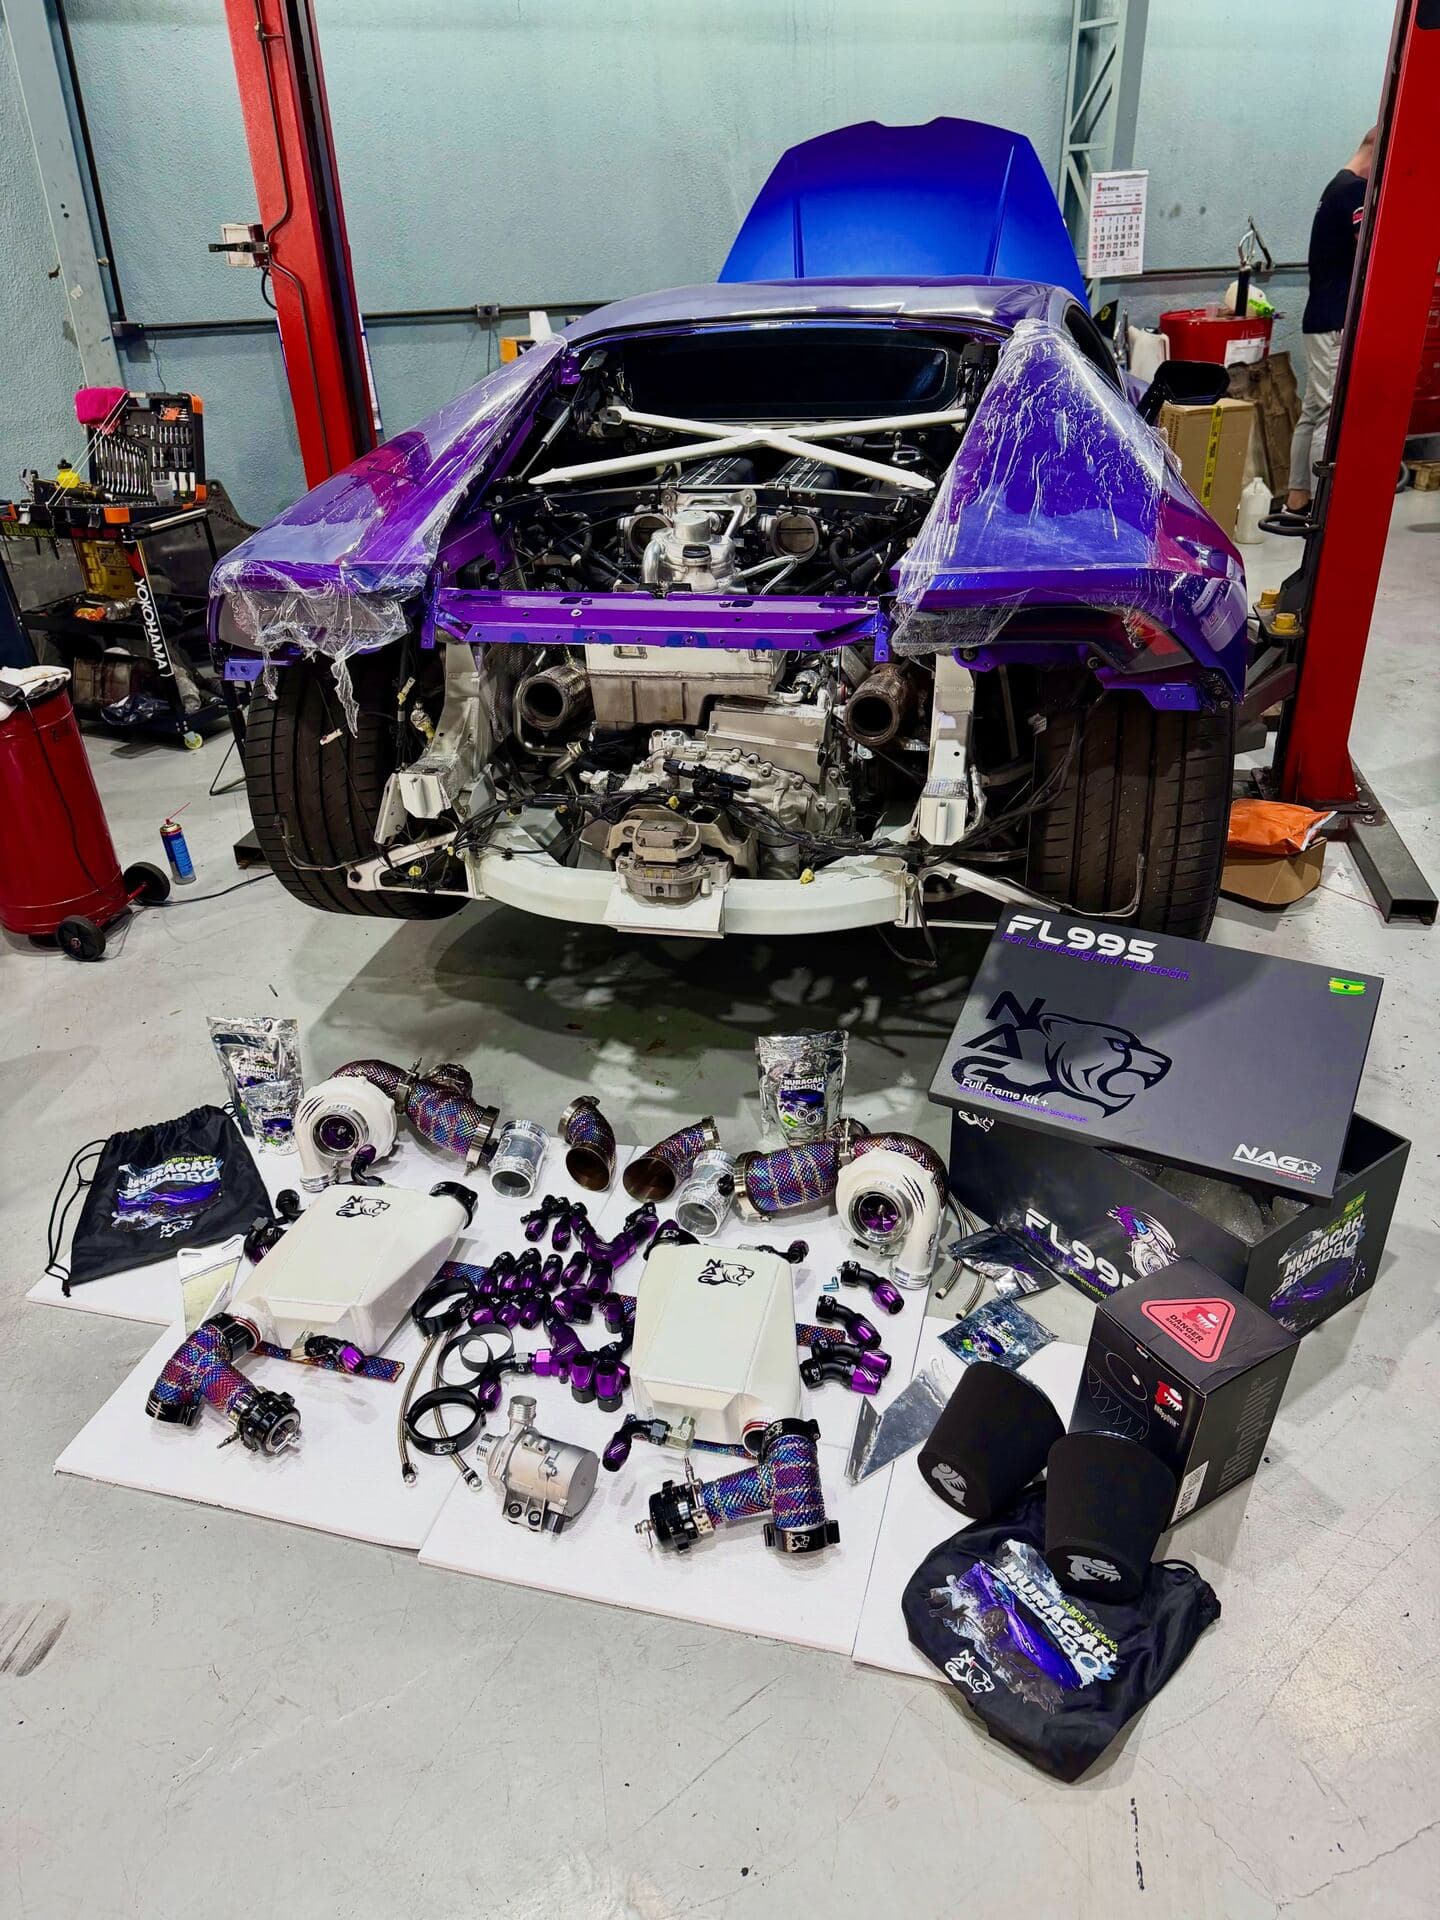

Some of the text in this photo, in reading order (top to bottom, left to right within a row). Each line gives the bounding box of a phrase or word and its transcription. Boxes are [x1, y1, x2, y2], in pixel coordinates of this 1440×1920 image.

[135, 578, 167, 669] YOKOHAMA
[1001, 932, 1024, 946] For
[1026, 937, 1120, 965] Lamborghini
[1006, 915, 1158, 964] FL995
[961, 1078, 982, 1090] Full
[984, 1084, 1020, 1100] Frame
[1022, 1093, 1038, 1106] Kit
[1233, 1143, 1300, 1170] NAG
[1165, 1317, 1184, 1333] SHARK
[1183, 1332, 1199, 1345] AREA
[1170, 1314, 1204, 1342] DANGER
